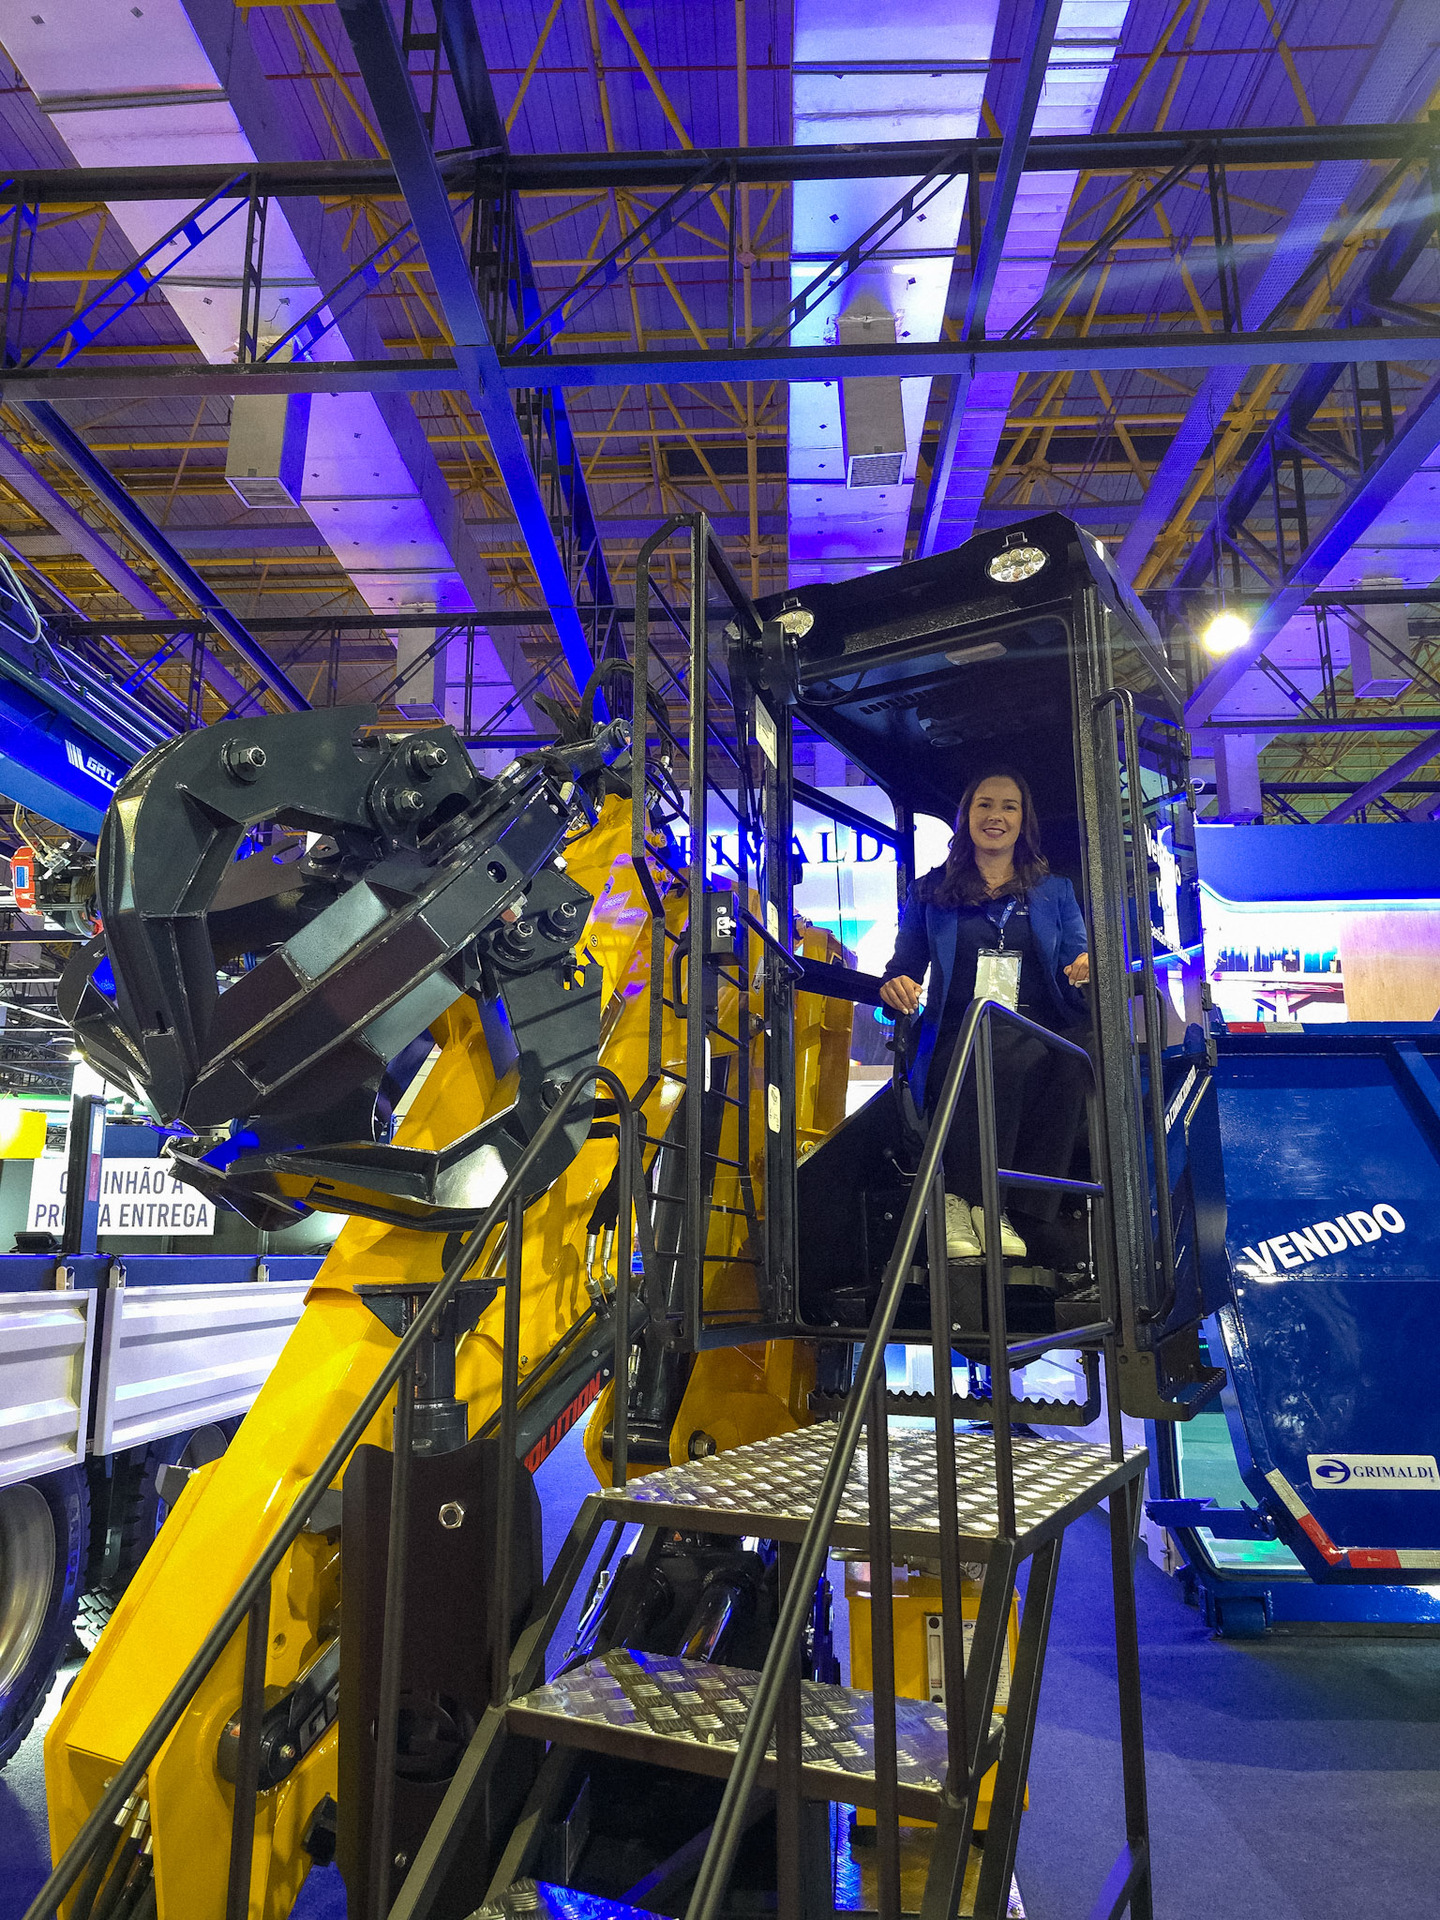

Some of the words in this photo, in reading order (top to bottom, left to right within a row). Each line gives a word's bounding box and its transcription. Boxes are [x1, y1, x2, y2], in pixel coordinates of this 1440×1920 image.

[86, 756, 115, 782] GRT
[59, 1166, 165, 1195] CINHÃO
[35, 1203, 111, 1228] PRA
[118, 1203, 208, 1228] ENTREGA
[1241, 1202, 1407, 1275] VENDIDO
[524, 1370, 601, 1474] OLUTION
[1353, 1465, 1434, 1479] GRIMALDI
